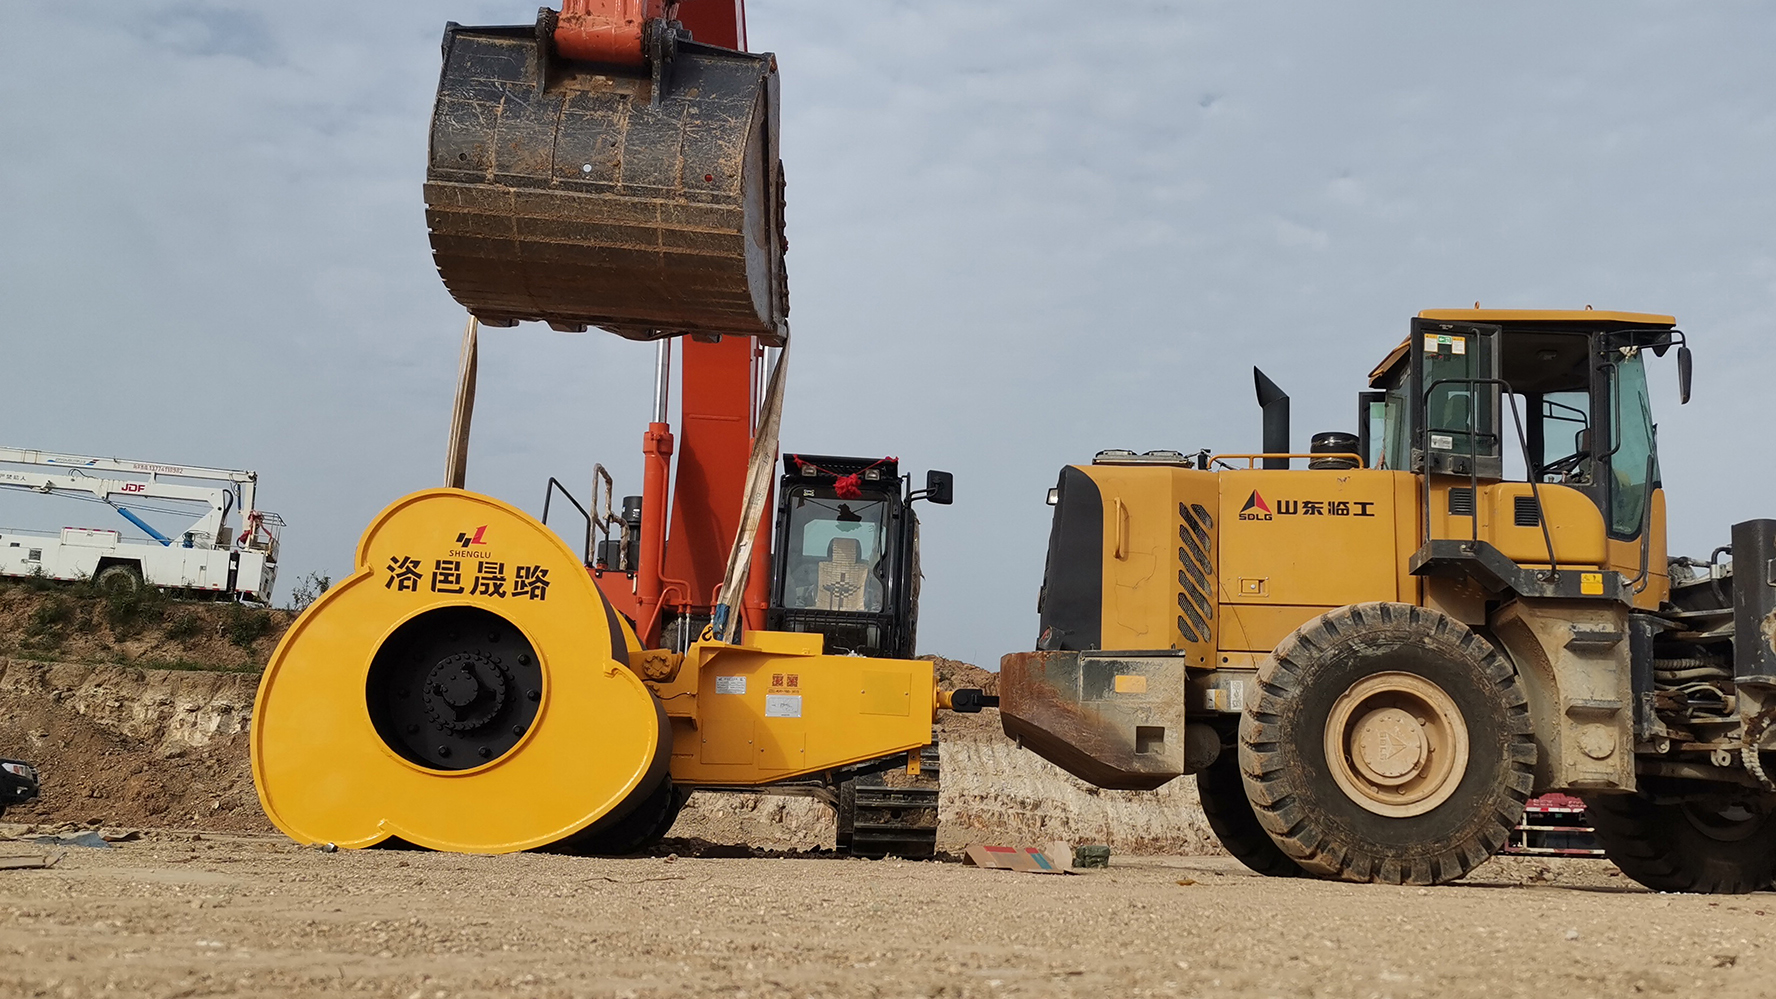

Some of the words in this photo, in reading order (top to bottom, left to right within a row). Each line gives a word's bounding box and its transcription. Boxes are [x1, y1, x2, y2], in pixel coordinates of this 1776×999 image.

[121, 483, 146, 493] JDF
[1277, 500, 1375, 517] 山东临工
[1239, 513, 1273, 521] SDLG
[448, 549, 492, 559] SHENGLU
[385, 555, 551, 601] 洛邑晟路
